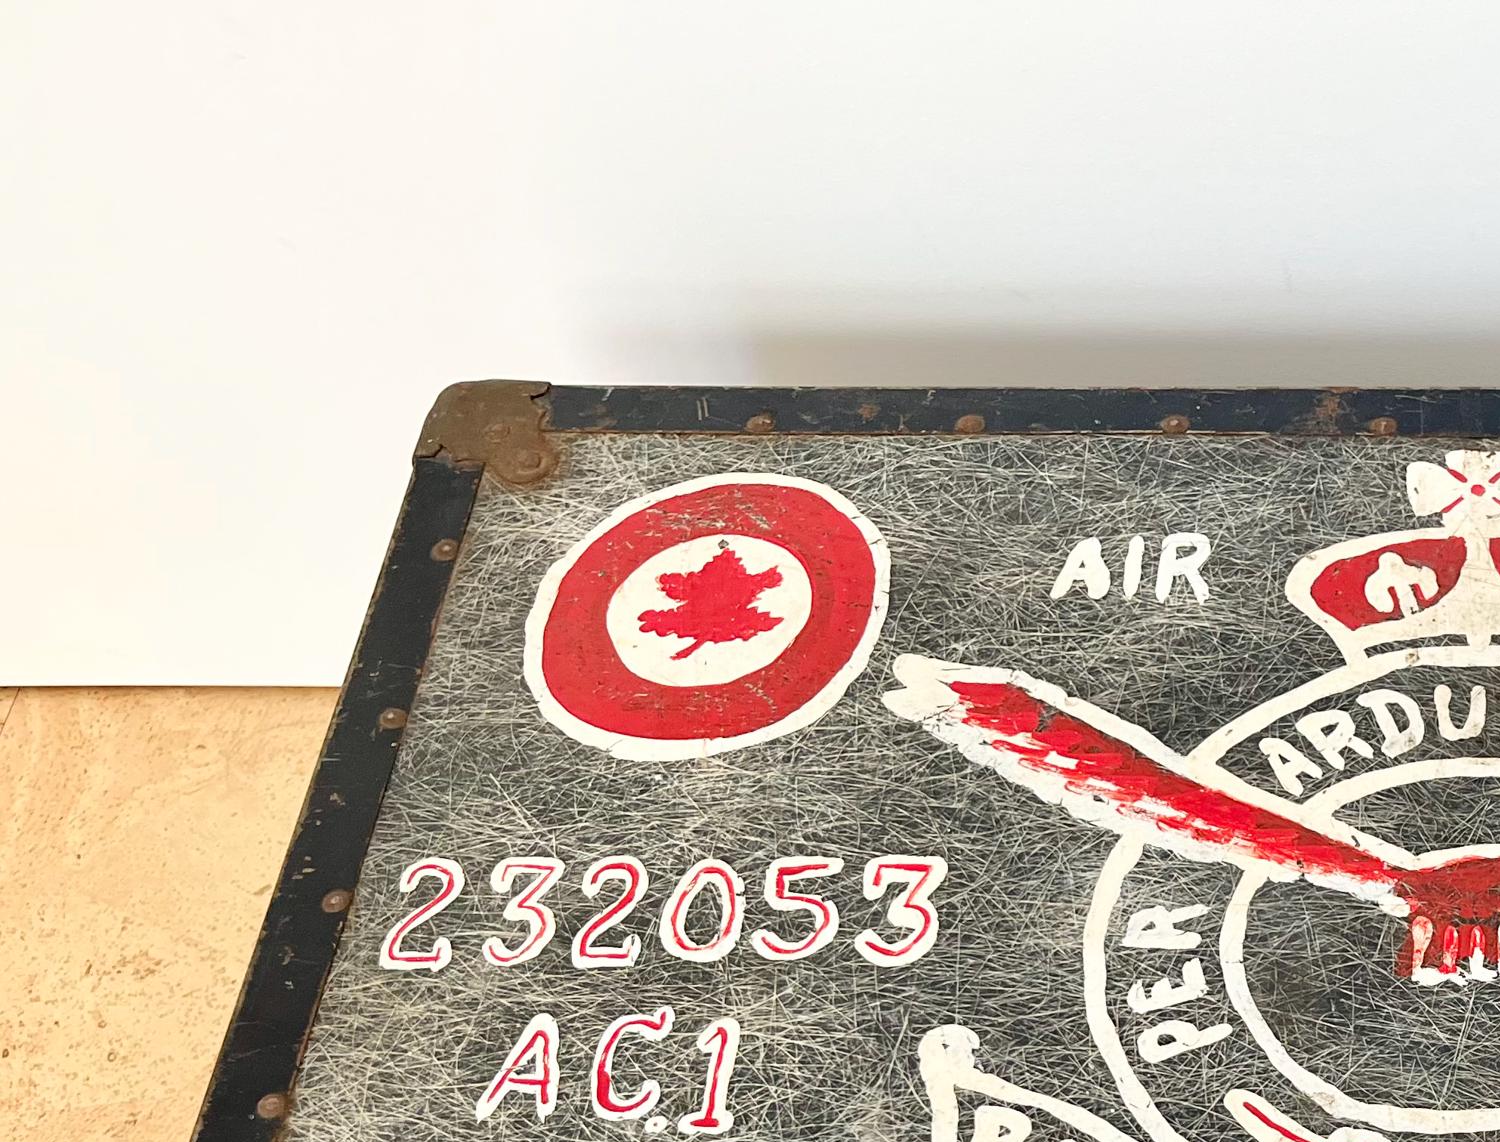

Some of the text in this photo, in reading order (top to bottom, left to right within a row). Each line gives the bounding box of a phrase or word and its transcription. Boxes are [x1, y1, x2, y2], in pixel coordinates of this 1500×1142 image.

[1049, 531, 1212, 604] AIR
[379, 854, 949, 970] 232053
[1120, 902, 1234, 1065] PER
